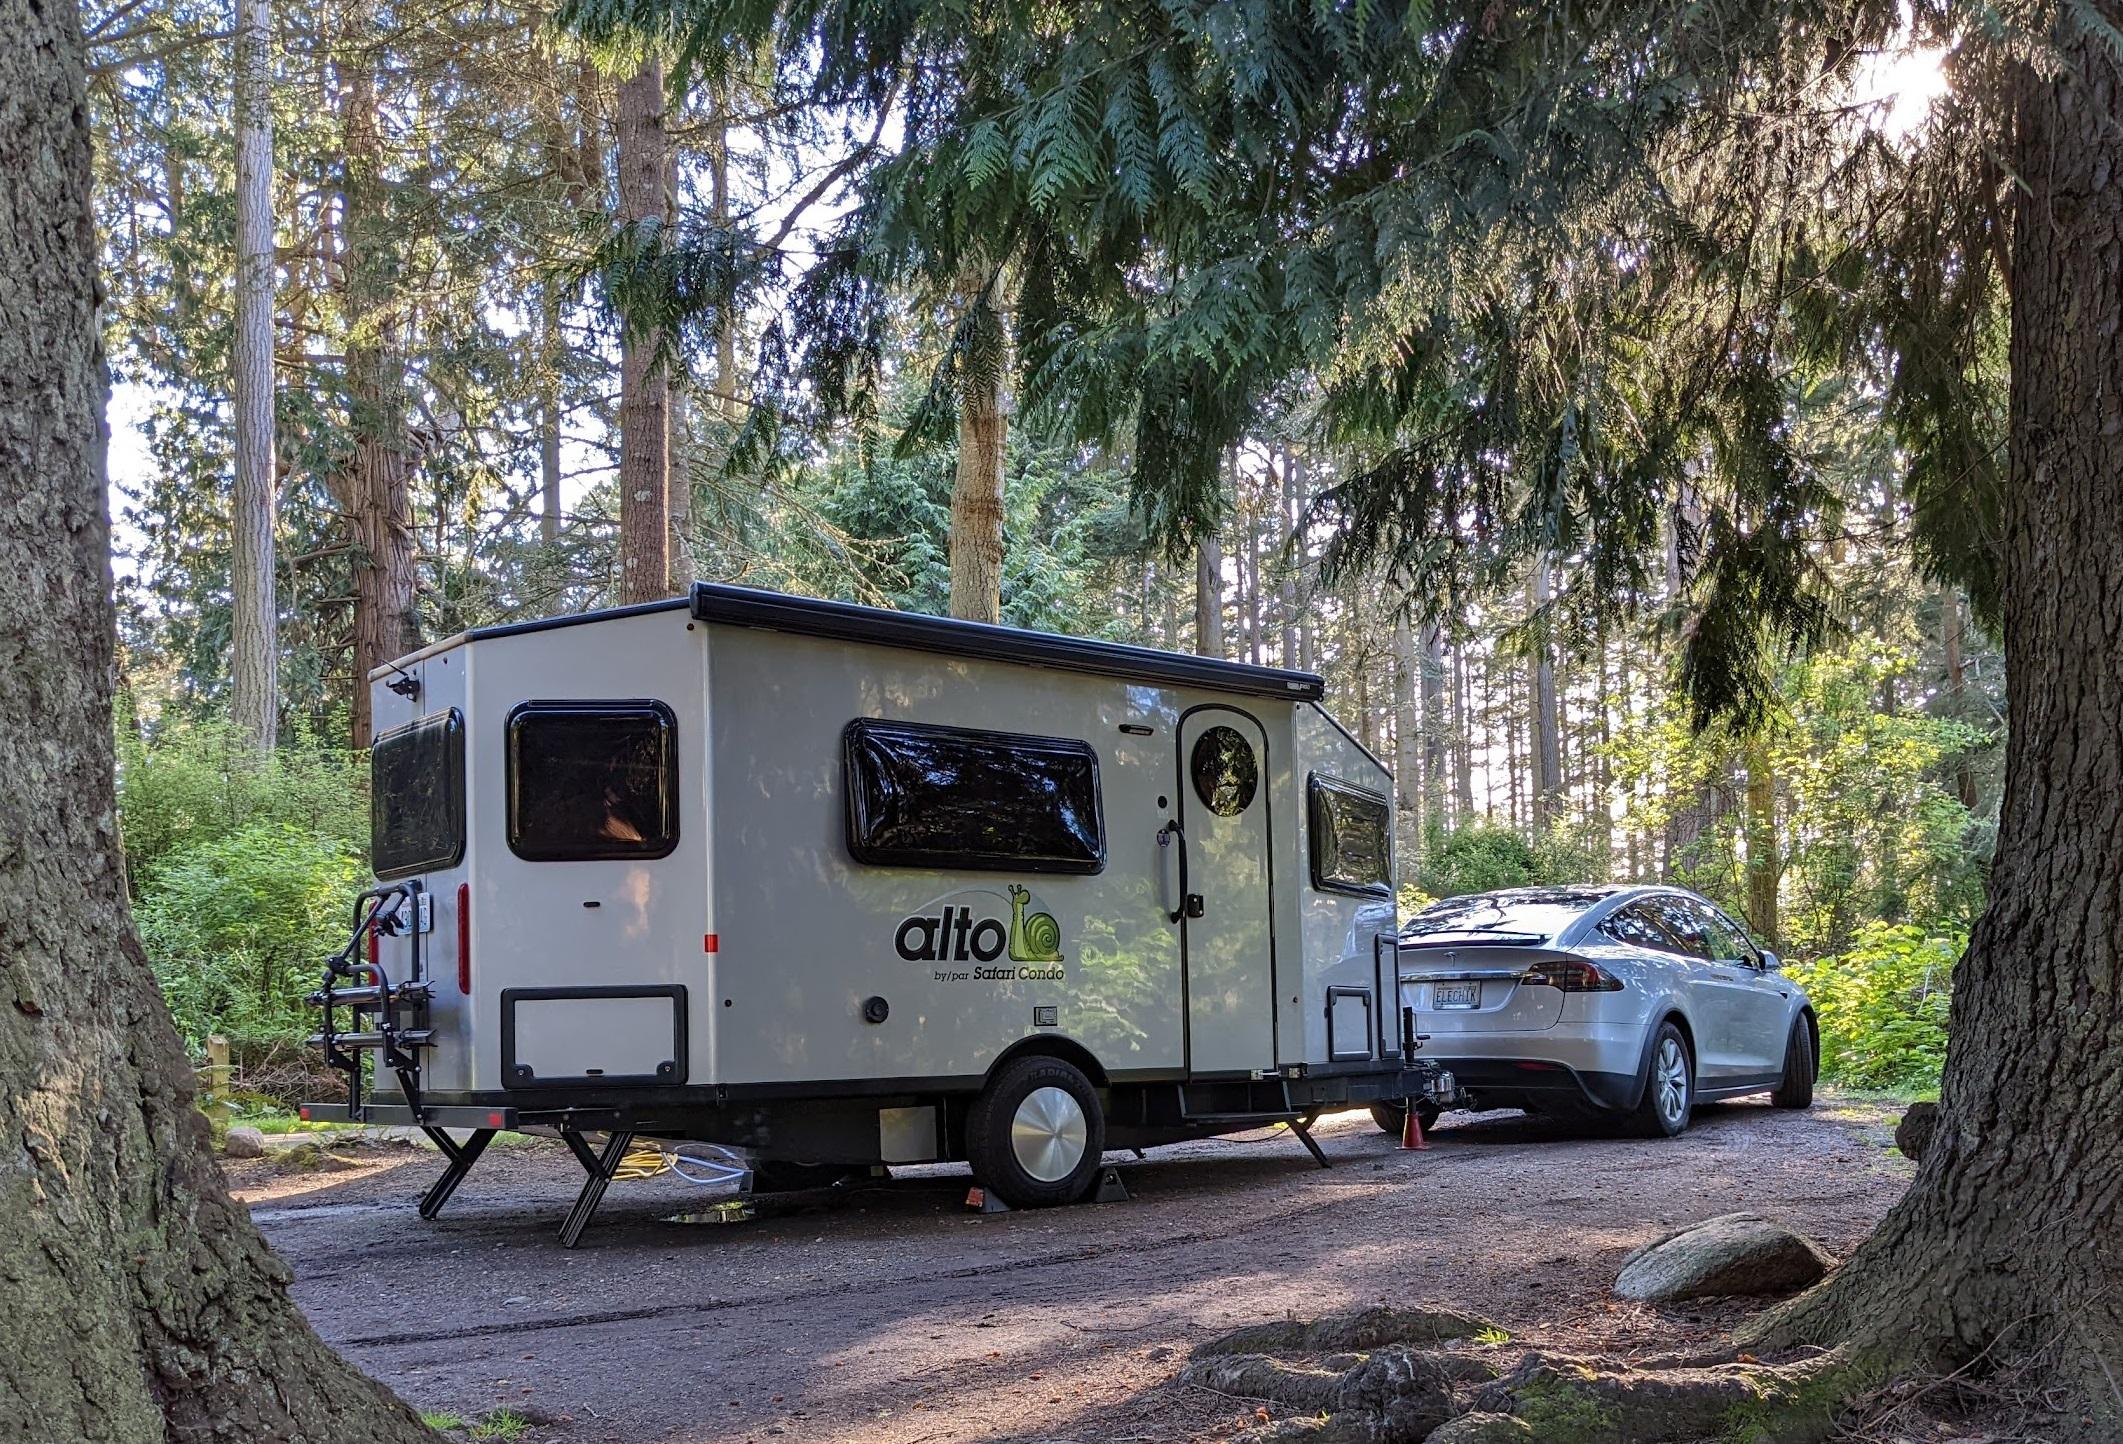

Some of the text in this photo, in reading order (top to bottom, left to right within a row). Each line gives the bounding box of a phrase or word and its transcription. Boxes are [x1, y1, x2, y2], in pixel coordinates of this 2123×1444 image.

[894, 906, 1007, 962] alto
[934, 966, 1064, 982] by/par Safari Condo
[1436, 990, 1477, 1003] ELECHIK
